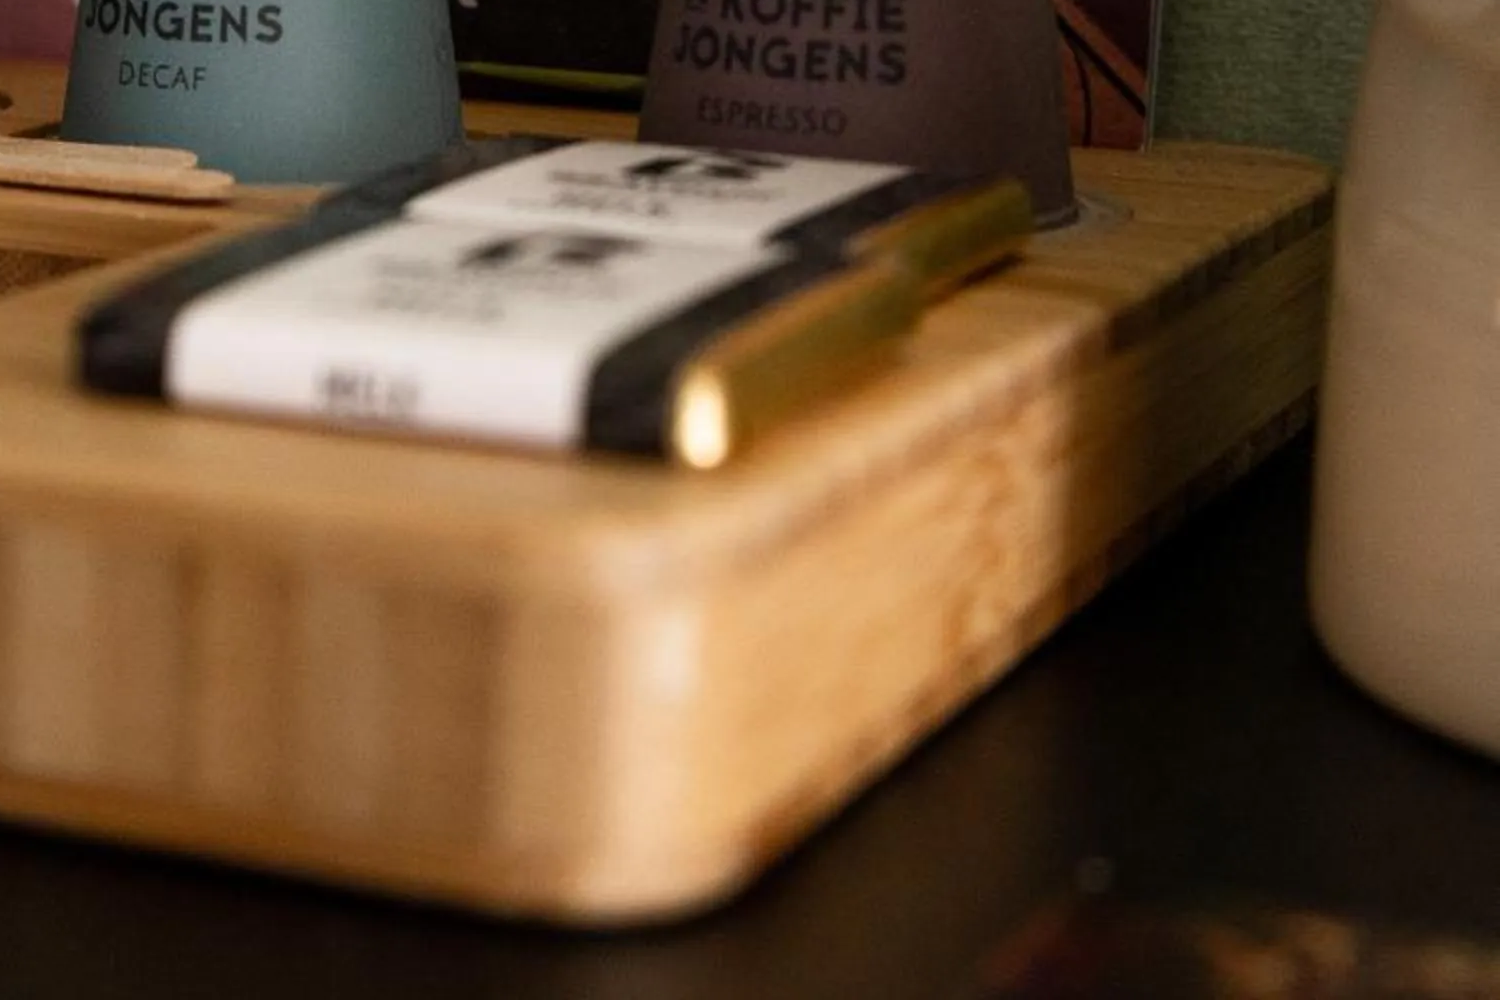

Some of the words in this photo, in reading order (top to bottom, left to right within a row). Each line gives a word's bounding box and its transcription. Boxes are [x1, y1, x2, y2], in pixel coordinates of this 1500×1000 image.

[673, 24, 906, 84] JONGENS
[118, 60, 207, 91] DECAF
[699, 96, 848, 138] ESPRESSO
